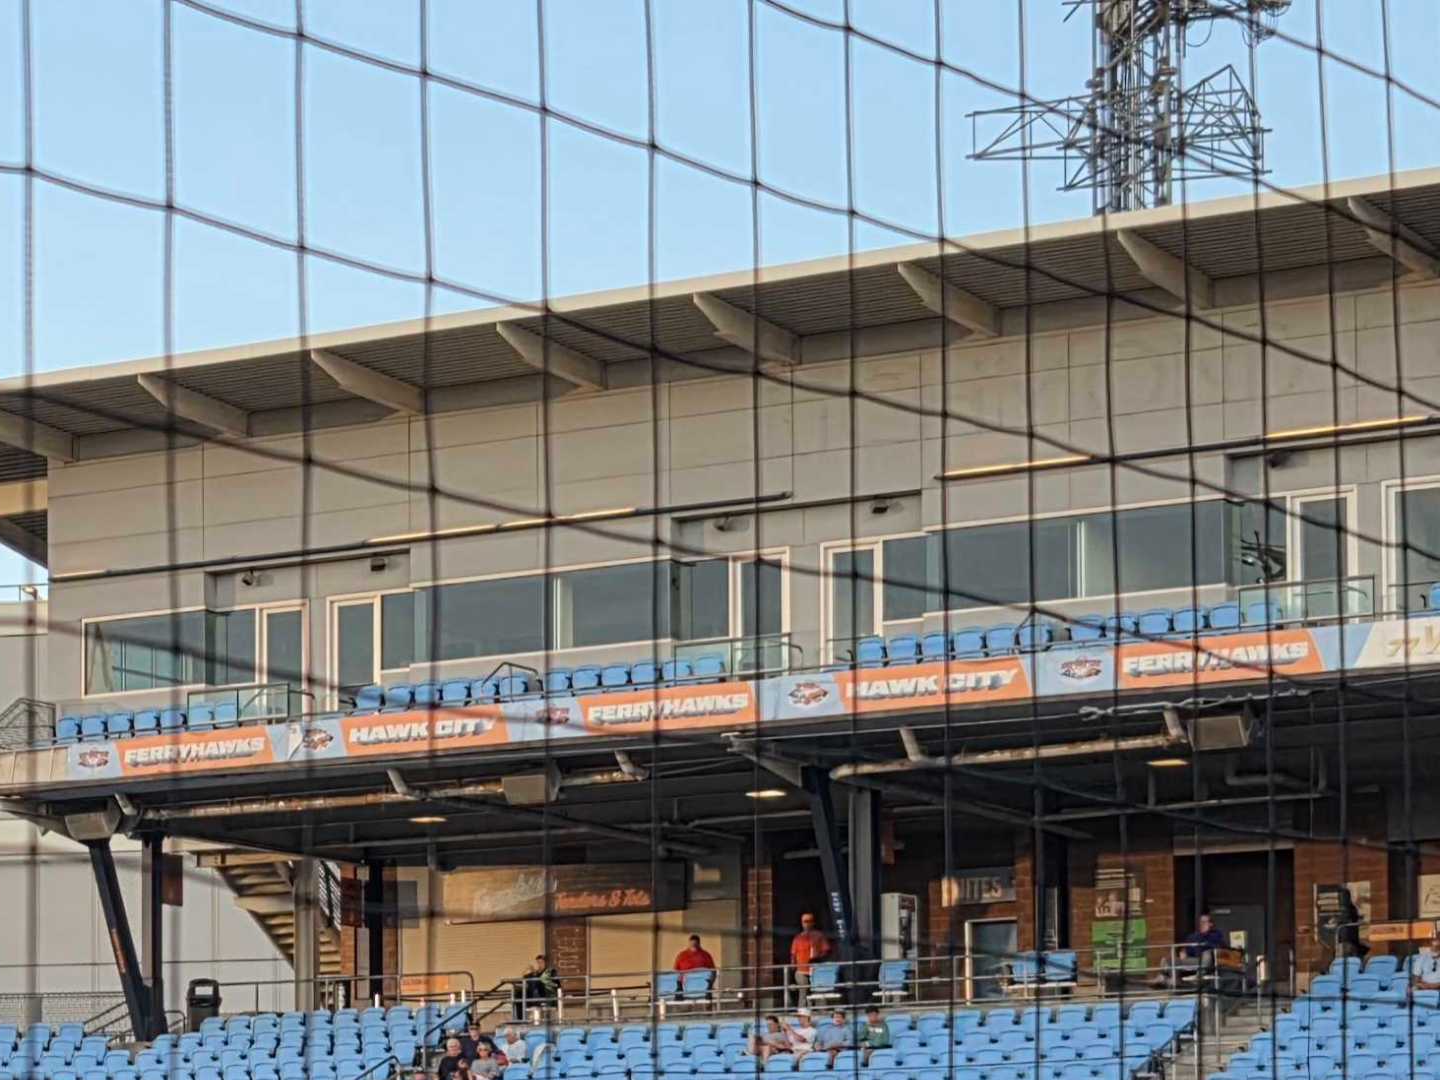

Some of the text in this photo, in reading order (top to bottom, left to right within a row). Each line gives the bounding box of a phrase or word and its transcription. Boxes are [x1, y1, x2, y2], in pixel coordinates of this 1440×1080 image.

[846, 668, 1019, 699] HAWK CITY
[587, 693, 749, 725] FERRYHAWKS
[349, 717, 496, 745] HAWK CITY
[123, 737, 266, 766] FERRYHAWKS
